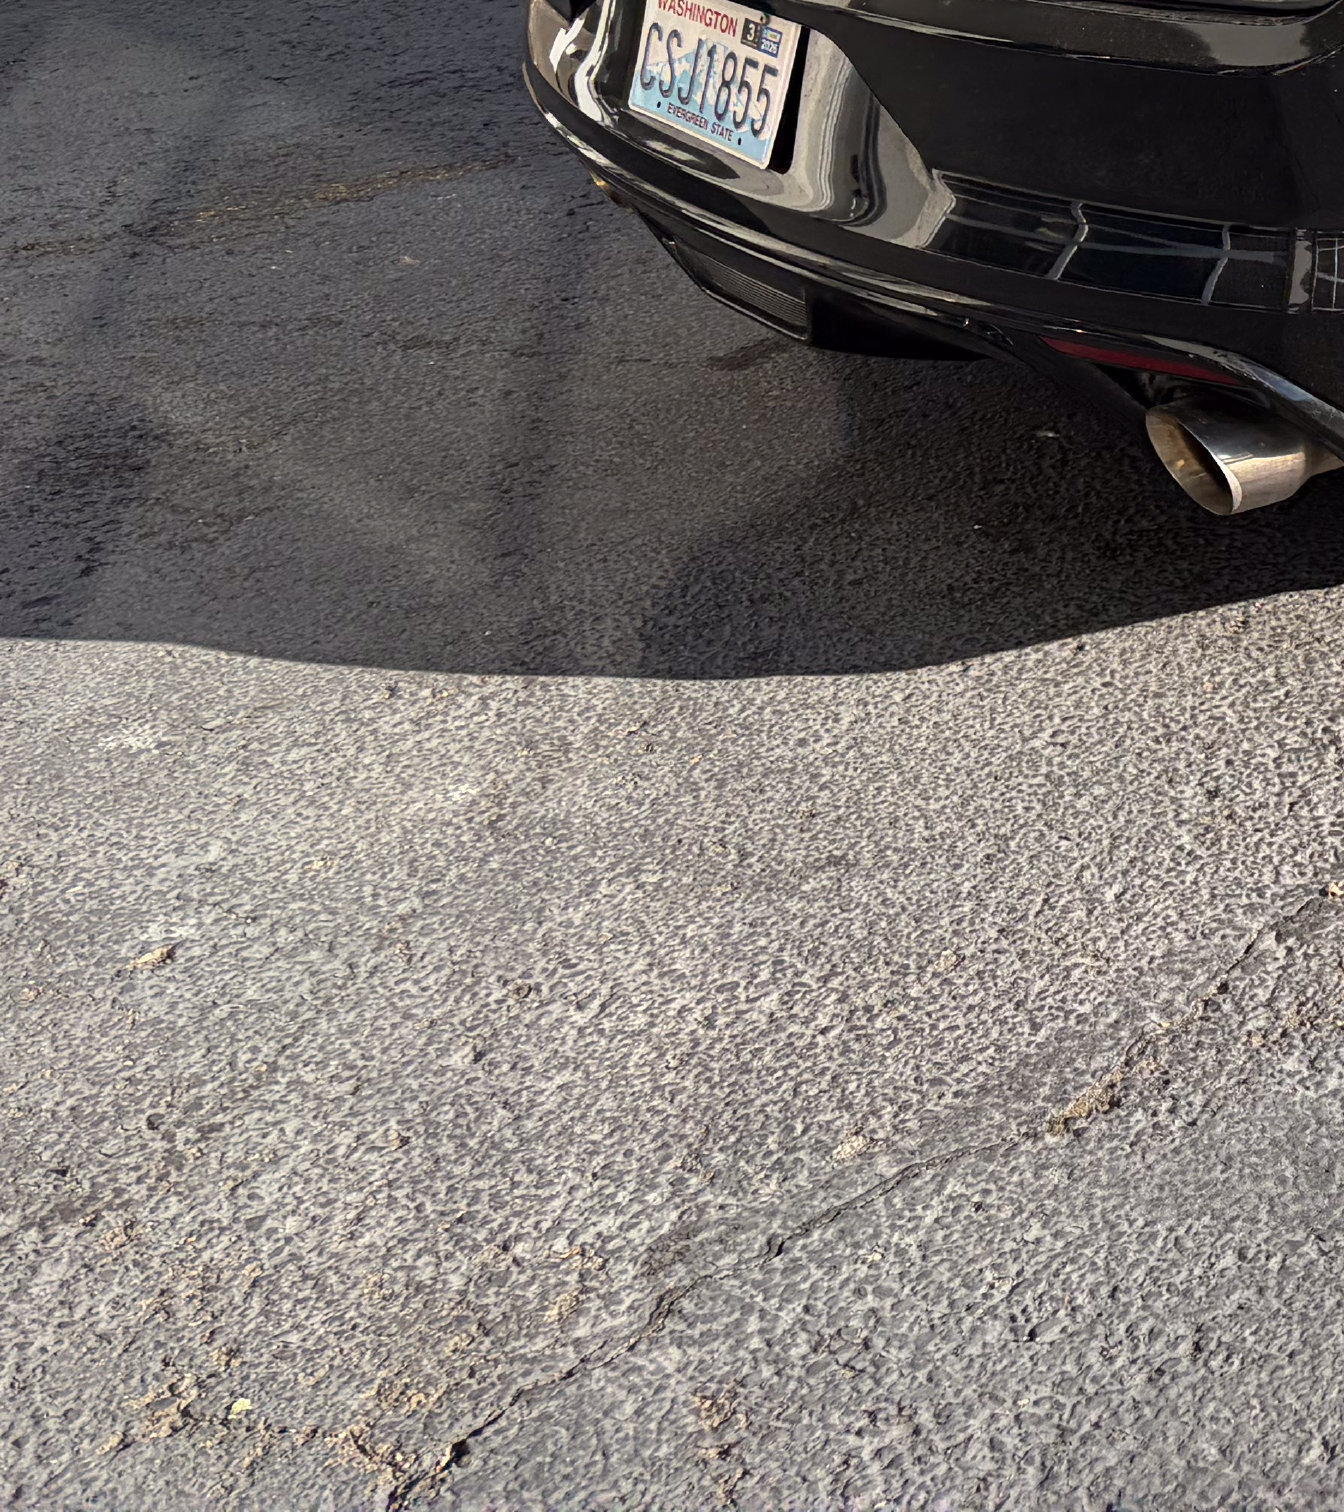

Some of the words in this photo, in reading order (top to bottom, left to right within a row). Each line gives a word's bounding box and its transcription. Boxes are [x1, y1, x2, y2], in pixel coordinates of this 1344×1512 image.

[746, 23, 756, 41] 3
[640, 22, 779, 138] CSJ1855
[666, 102, 709, 131] EVERGREEN
[711, 121, 734, 142] STATE
